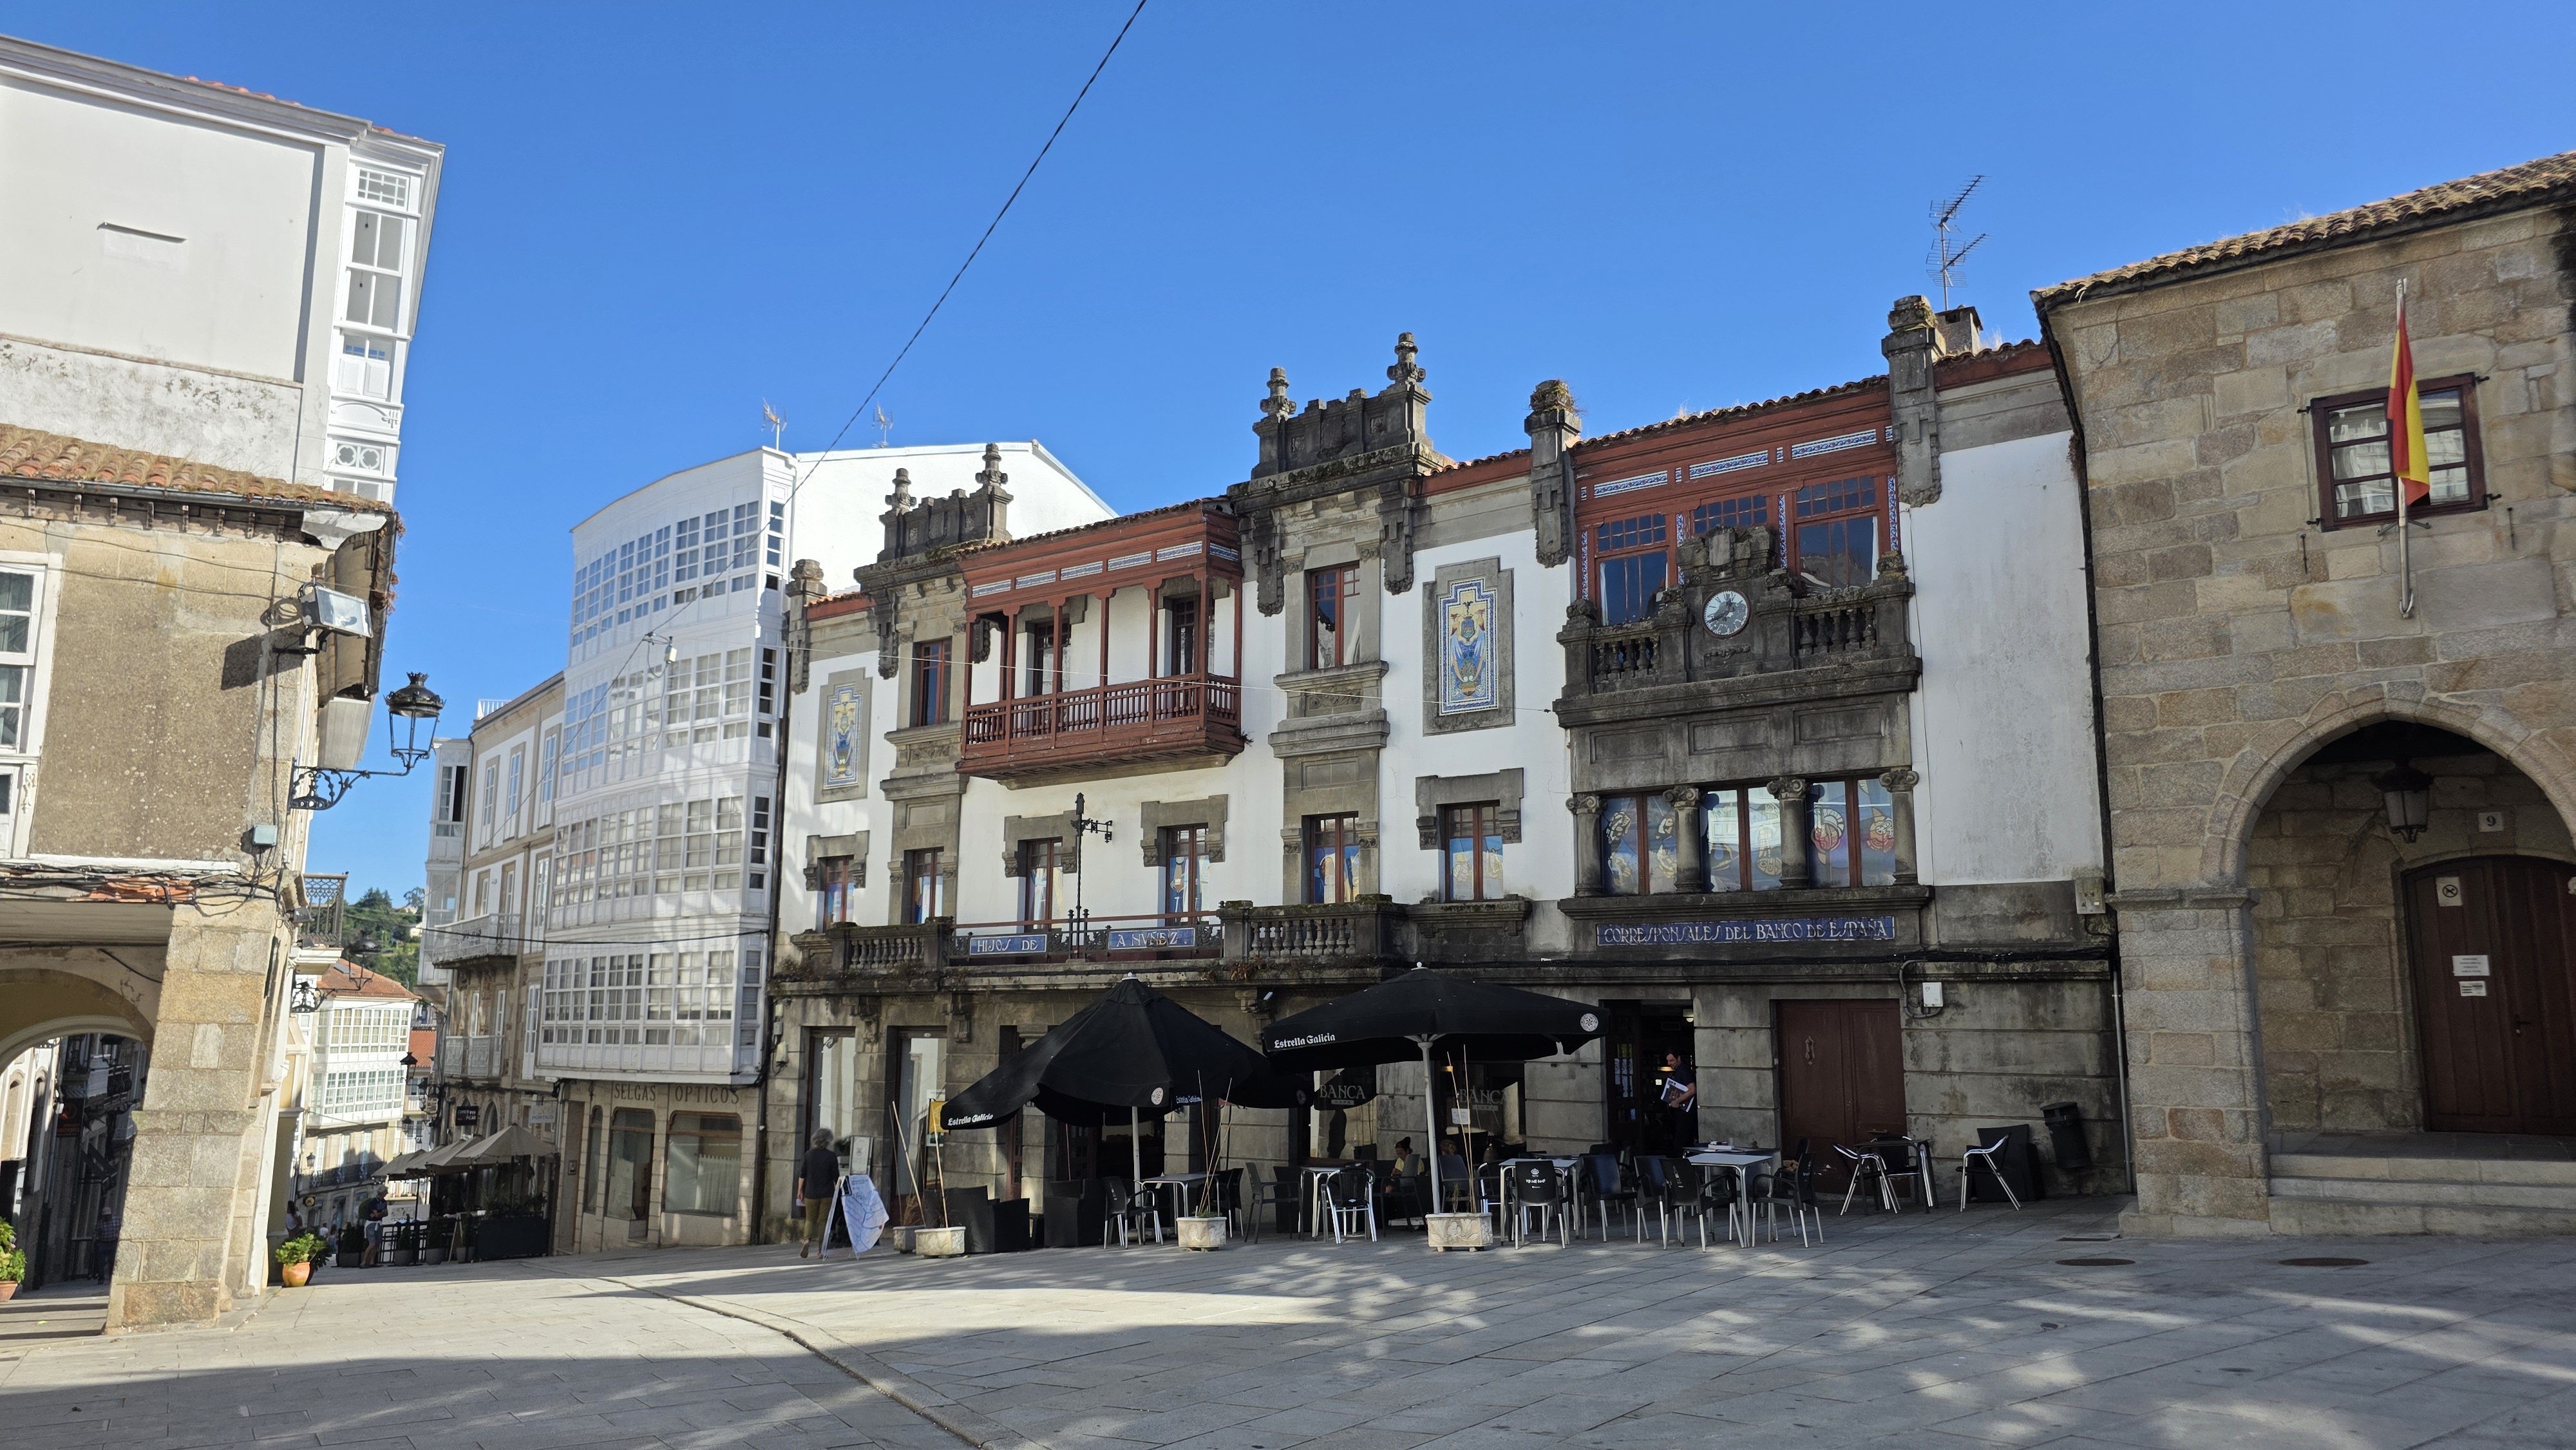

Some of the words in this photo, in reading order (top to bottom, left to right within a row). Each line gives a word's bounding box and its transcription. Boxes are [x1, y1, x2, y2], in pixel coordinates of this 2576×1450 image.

[2486, 815, 2496, 827] 9
[1116, 934, 1125, 947] A
[1604, 925, 1721, 944] CORRESPONSALES
[1725, 926, 1752, 941] DEL
[1756, 923, 1803, 939] BANCO
[1807, 924, 1826, 937] DE
[977, 939, 1010, 952] HIJOS
[1022, 939, 1039, 951] DE
[1274, 1039, 1306, 1048] Estrella
[1306, 1033, 1336, 1044] Galicia
[614, 1083, 656, 1102] SELGAS
[675, 1085, 739, 1104] OPTICOS
[1320, 1084, 1366, 1099] BANCA
[948, 1116, 971, 1125] Estrella
[972, 1113, 994, 1122] Galicia
